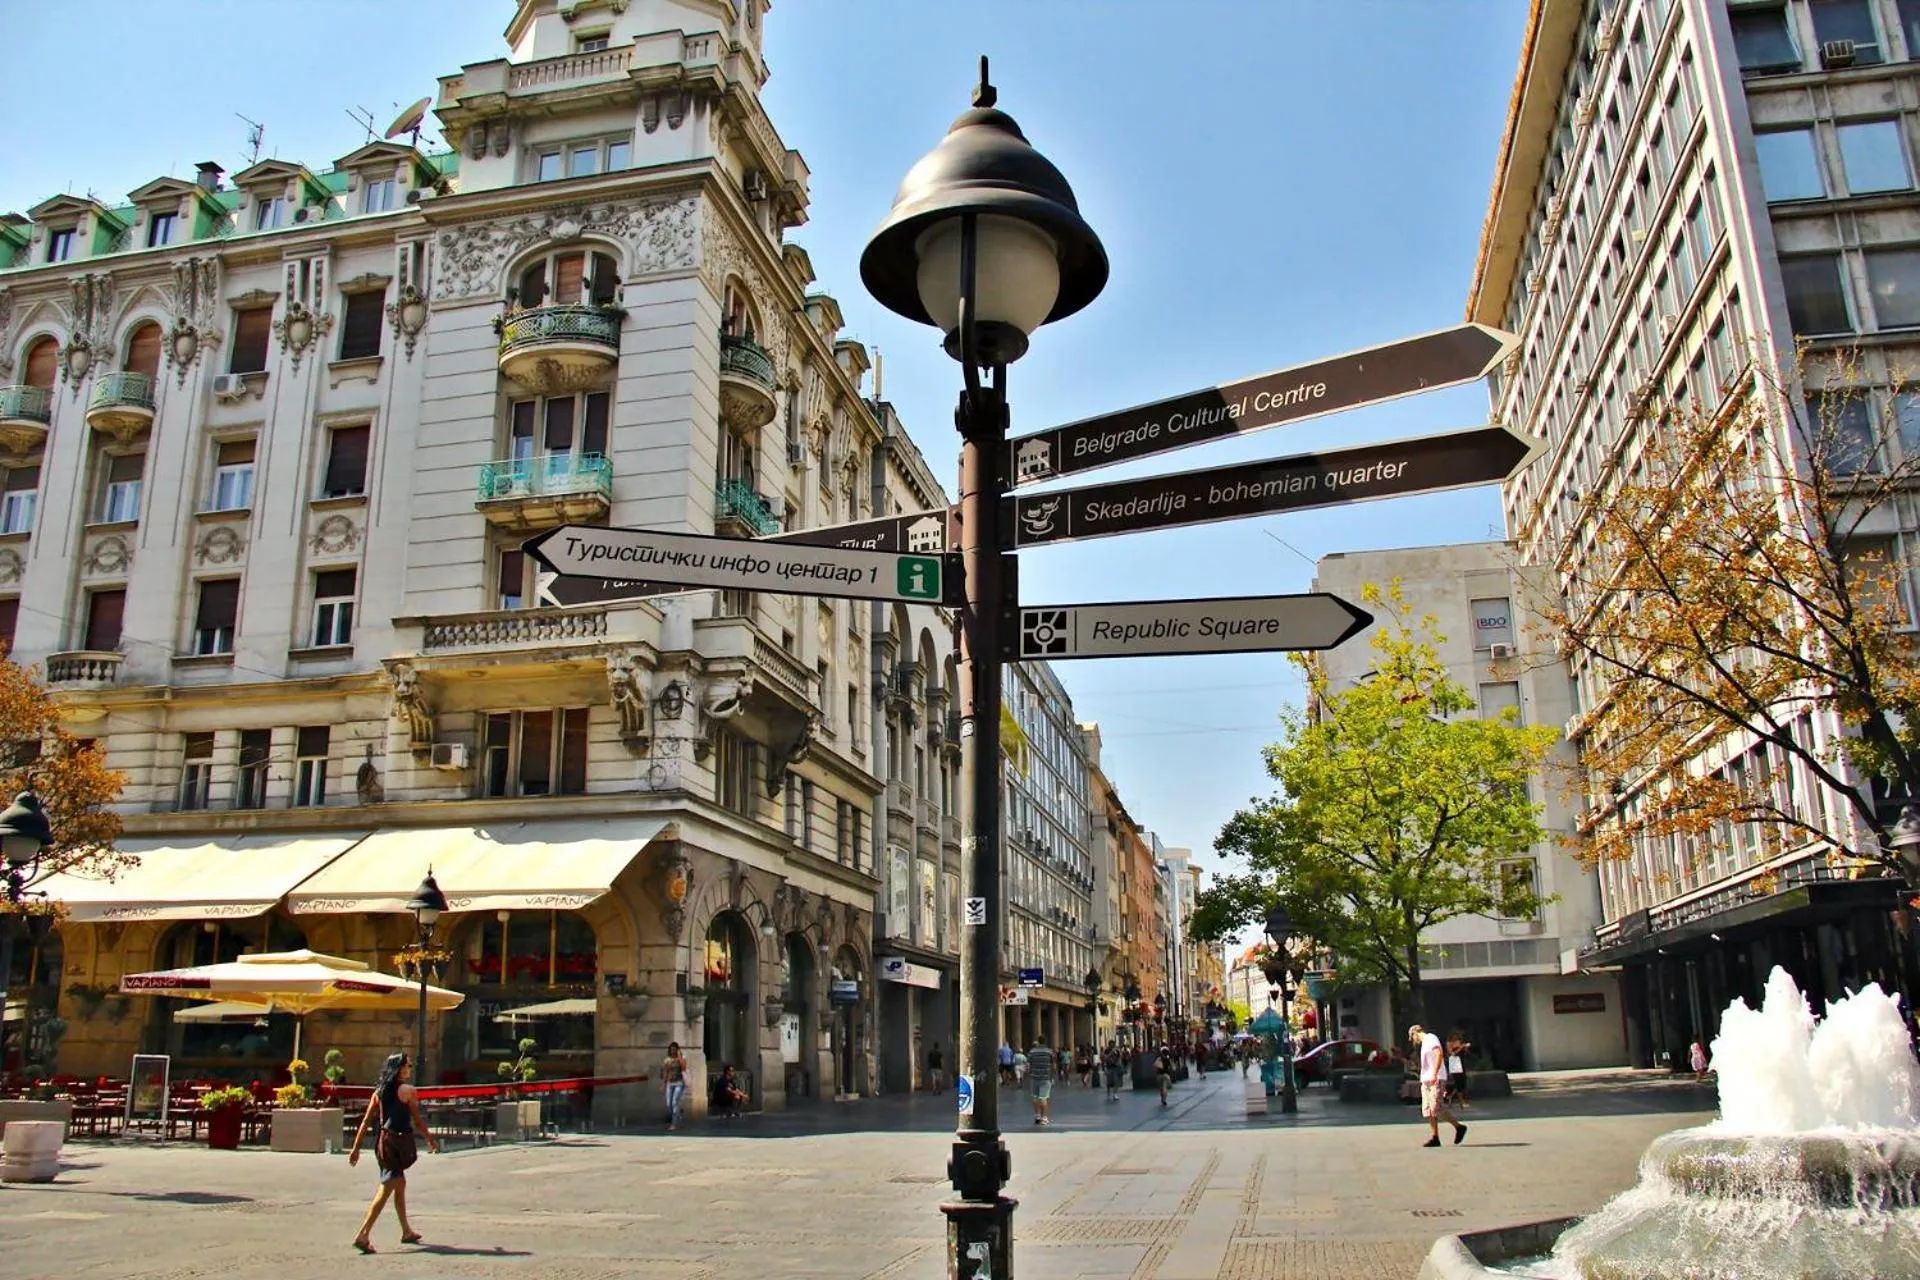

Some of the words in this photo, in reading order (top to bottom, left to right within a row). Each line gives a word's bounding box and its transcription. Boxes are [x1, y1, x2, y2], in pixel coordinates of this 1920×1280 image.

[1073, 421, 1162, 457] Belgrade
[1167, 397, 1247, 434] Cultural
[1253, 380, 1327, 413] Centre
[1084, 492, 1187, 523] Skadarlija
[1208, 471, 1317, 505] bohemian
[1324, 460, 1408, 501] quarter
[565, 537, 706, 571] Туристички
[709, 551, 770, 577] инфо
[775, 556, 863, 585] центар
[869, 567, 878, 584] 1
[1093, 618, 1191, 643] Republic
[1198, 615, 1280, 640] Square
[1480, 617, 1506, 626] BDO
[103, 906, 160, 918] VAPIANO
[296, 899, 357, 911] VAPIANO
[126, 977, 177, 989] VAPIANO
